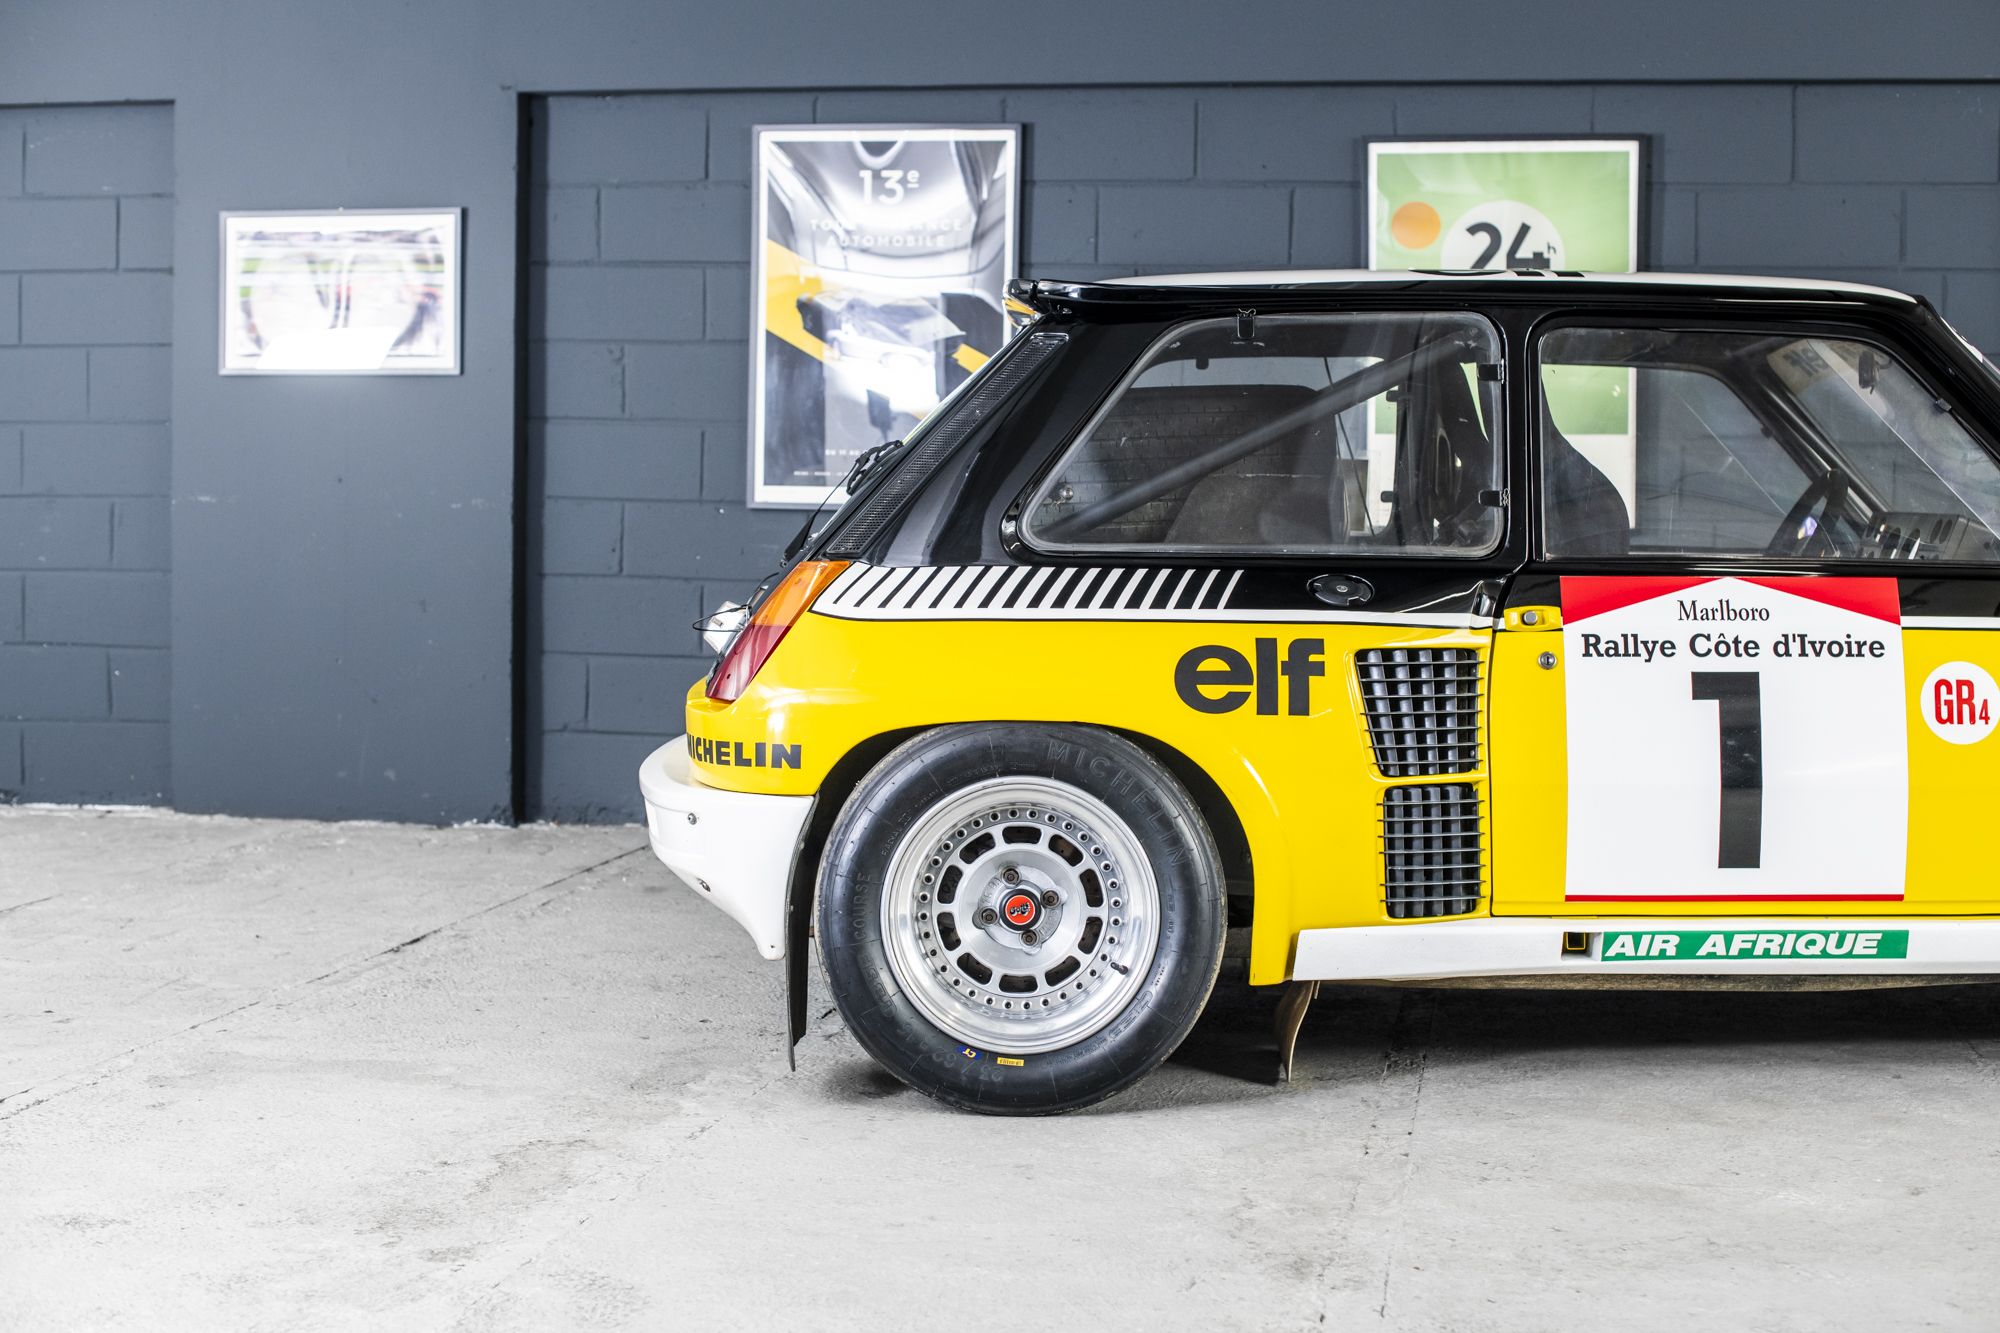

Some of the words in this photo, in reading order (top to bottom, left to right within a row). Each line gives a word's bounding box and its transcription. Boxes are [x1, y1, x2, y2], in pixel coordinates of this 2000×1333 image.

[1677, 598, 1770, 622] Marlboro
[1174, 637, 1326, 716] elf
[1581, 633, 1677, 663] Rallye
[1688, 632, 1761, 658] Côte
[1772, 633, 1886, 658] d'Ivoire
[1047, 740, 1189, 867] MICHELIN
[1691, 671, 1762, 868] 1
[853, 872, 871, 940] COURSE
[1605, 933, 1680, 957] AIR
[1696, 931, 1882, 957] AFRIQUE
